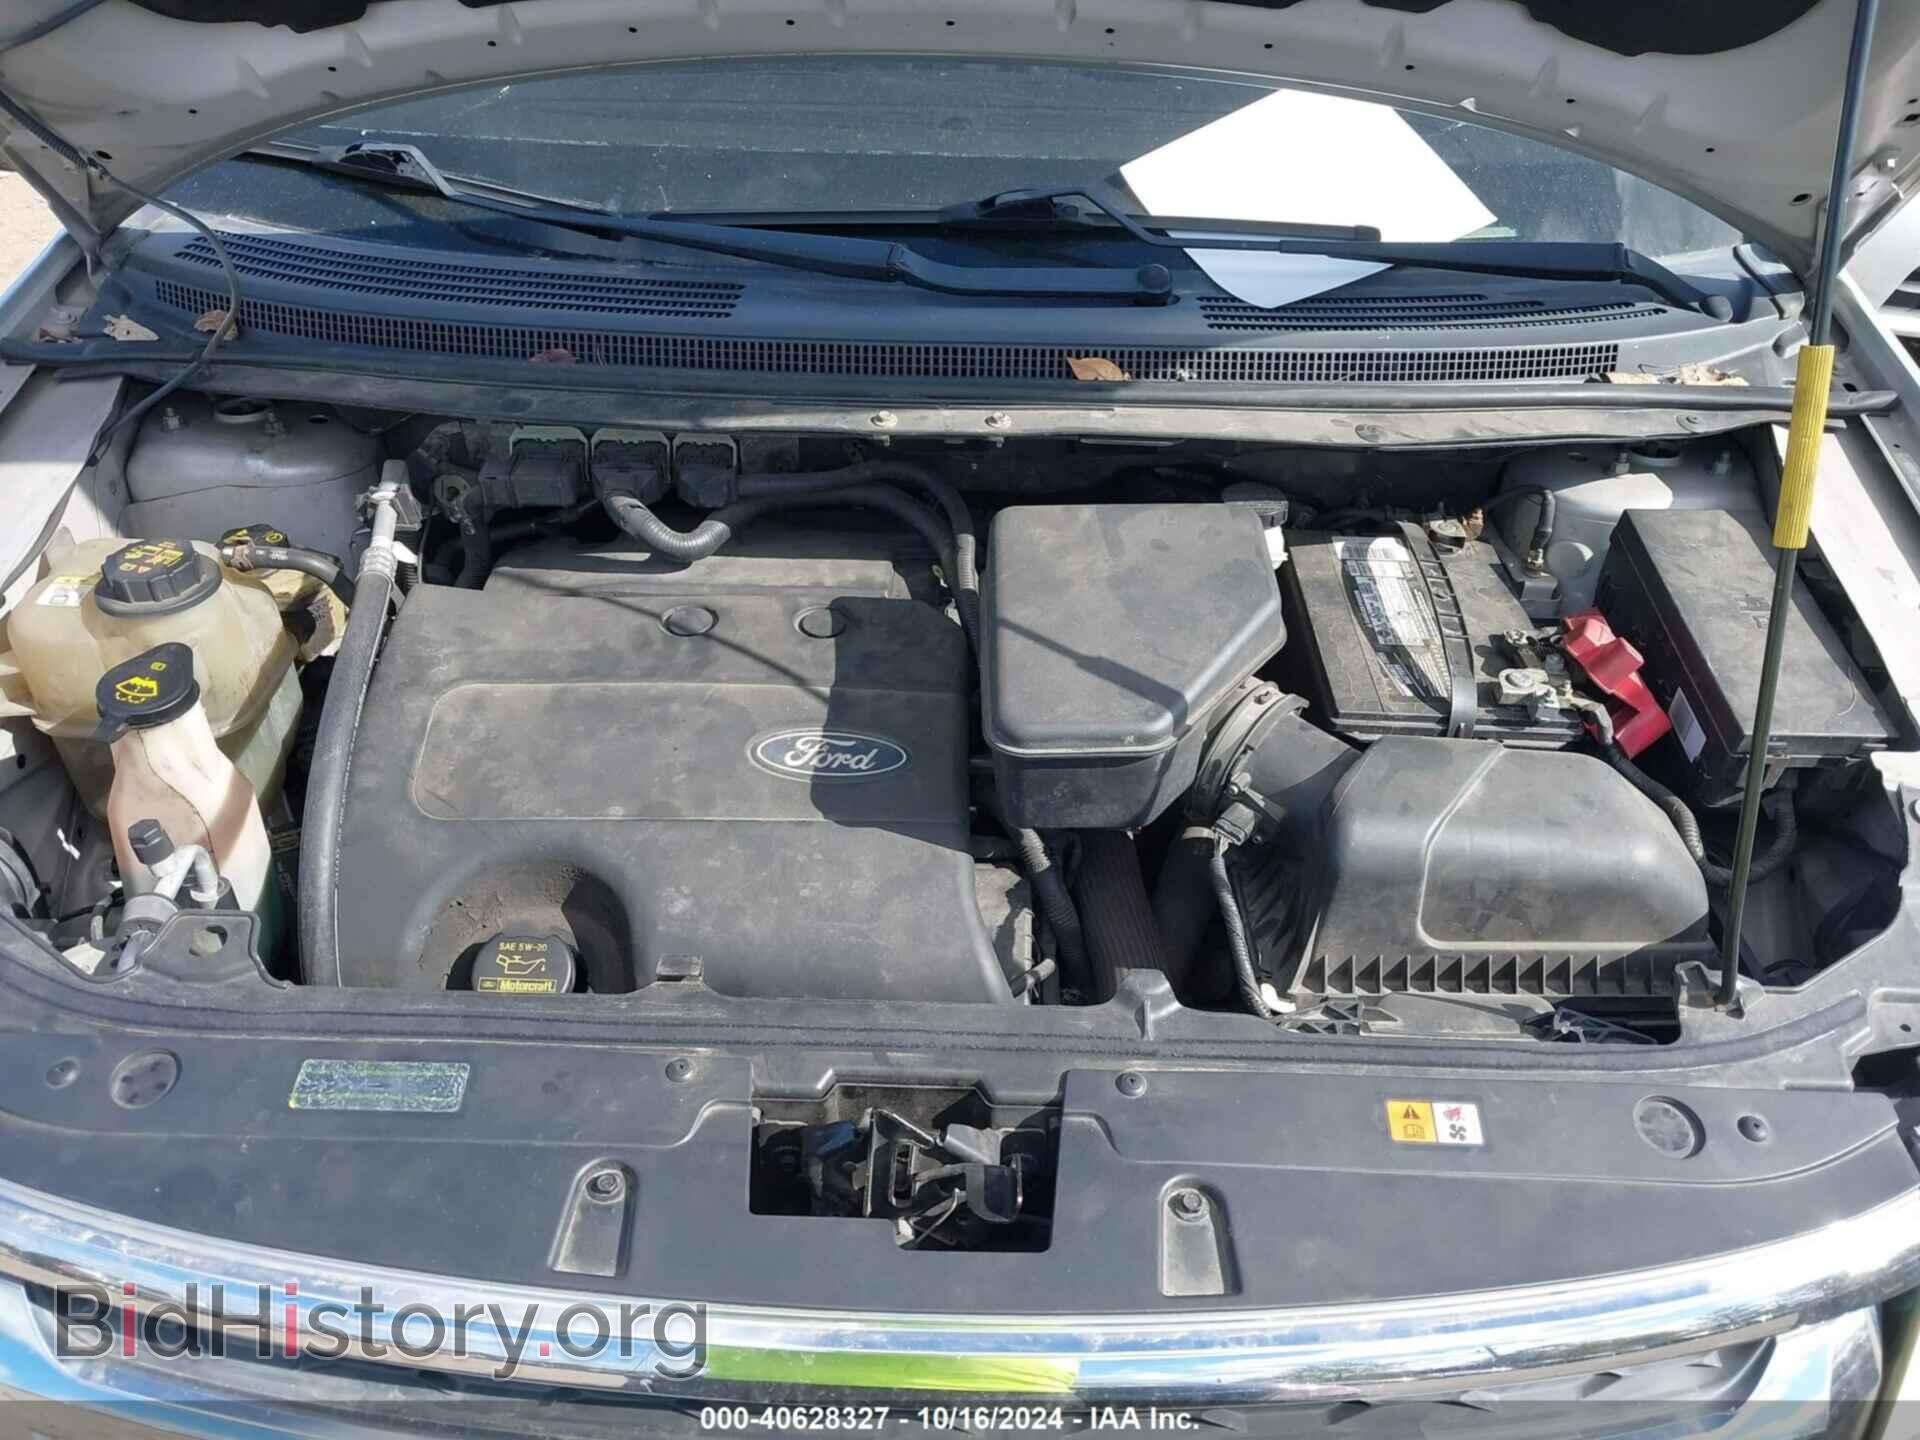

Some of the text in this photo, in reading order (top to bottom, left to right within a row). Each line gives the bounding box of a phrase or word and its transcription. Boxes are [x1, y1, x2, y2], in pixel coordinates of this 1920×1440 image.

[783, 735, 879, 771] Ford
[498, 941, 548, 953] SAE 5W-20
